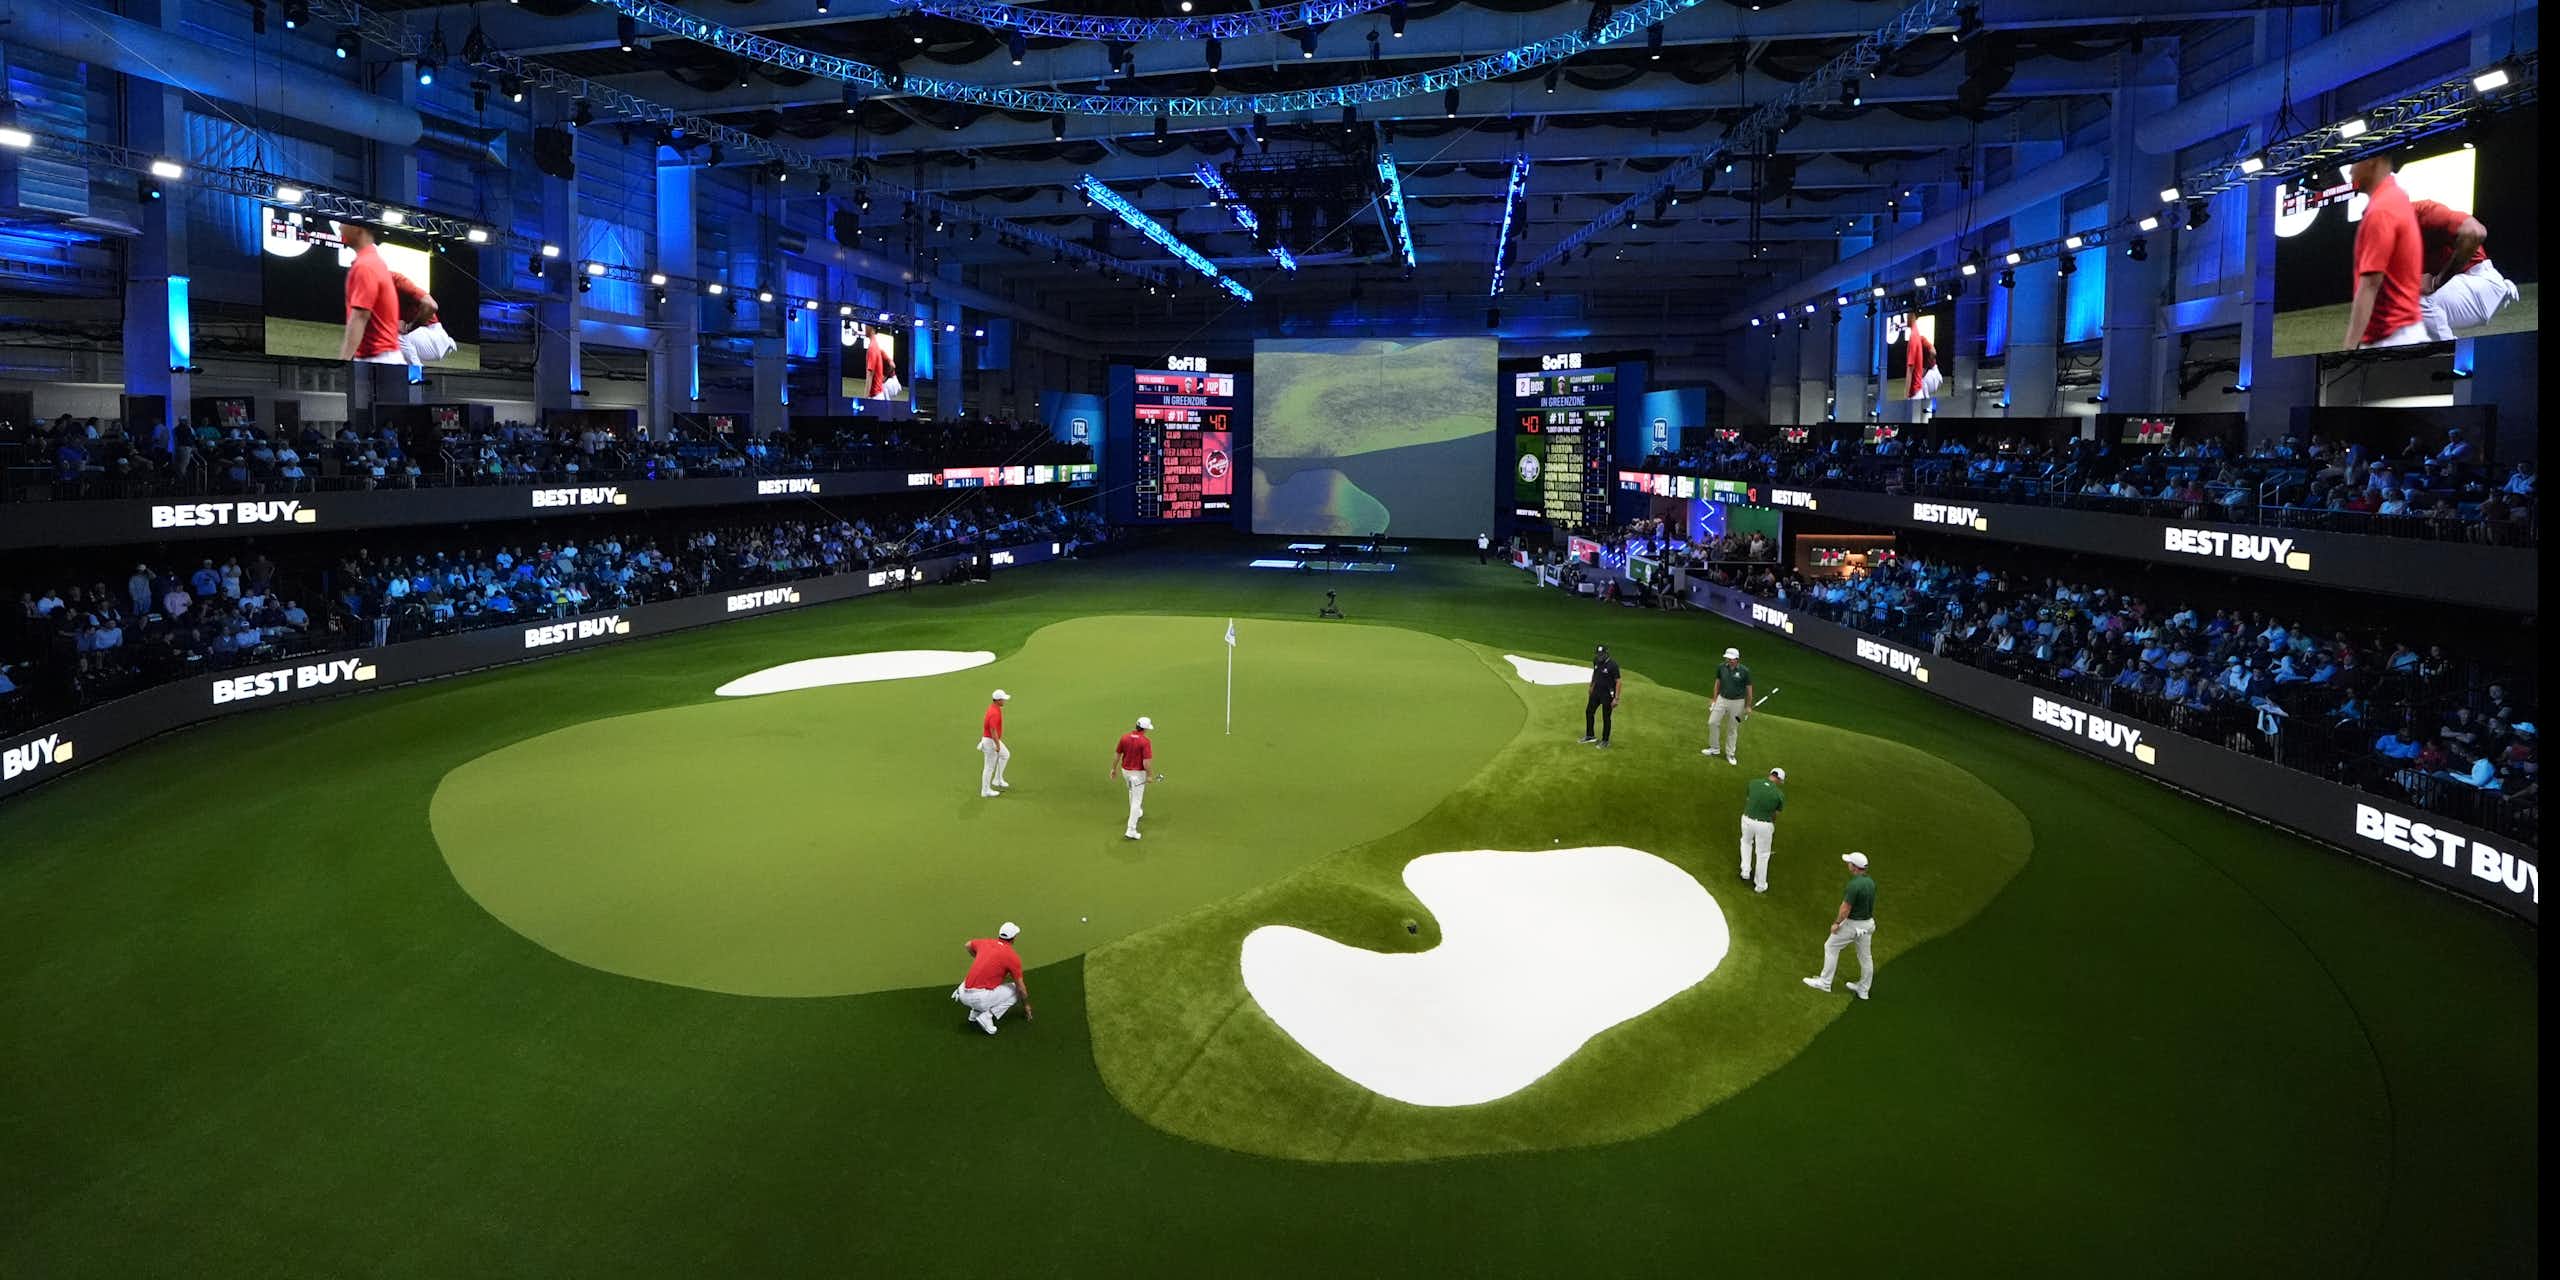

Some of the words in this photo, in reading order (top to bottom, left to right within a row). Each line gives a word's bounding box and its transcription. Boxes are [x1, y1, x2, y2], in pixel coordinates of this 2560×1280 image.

[1168, 355, 1194, 371] SoFi
[1542, 354, 1568, 370] SoFi
[1163, 395, 1170, 405] IN
[1171, 396, 1208, 406] GREENZONE
[1540, 397, 1547, 407] IN
[1548, 395, 1585, 407] GREENZONE
[1209, 414, 1227, 431] 40
[1522, 415, 1539, 433] 40
[1551, 444, 1573, 453] BOSTON
[1163, 457, 1178, 465] CLUB
[1165, 466, 1186, 474] JUPITER
[758, 479, 788, 495] BEST
[789, 478, 814, 493] BUY
[532, 489, 579, 507] BEST
[580, 487, 617, 505] BUY
[1172, 501, 1193, 510] JUPITER
[1771, 489, 1792, 506] BEST
[1792, 491, 1812, 507] BUY
[152, 503, 234, 528] BEST
[237, 500, 300, 523] BUY
[1913, 502, 1947, 524] BEST
[1948, 505, 1979, 527] BUY
[2165, 527, 2229, 557] BEST
[2231, 533, 2294, 564] BUY
[727, 591, 763, 612] BEST
[763, 587, 793, 607] BUY
[1767, 607, 1789, 629] BUY
[525, 621, 578, 648] BEST
[579, 615, 620, 638] BUY
[1856, 637, 1890, 666] BEST
[1890, 648, 1921, 676] BUY
[212, 669, 293, 704] BEST
[297, 658, 360, 689] BUY
[2032, 696, 2087, 735] BEST
[2088, 714, 2141, 754] BUY
[3, 733, 59, 780] BUY
[2356, 803, 2466, 868] BEST
